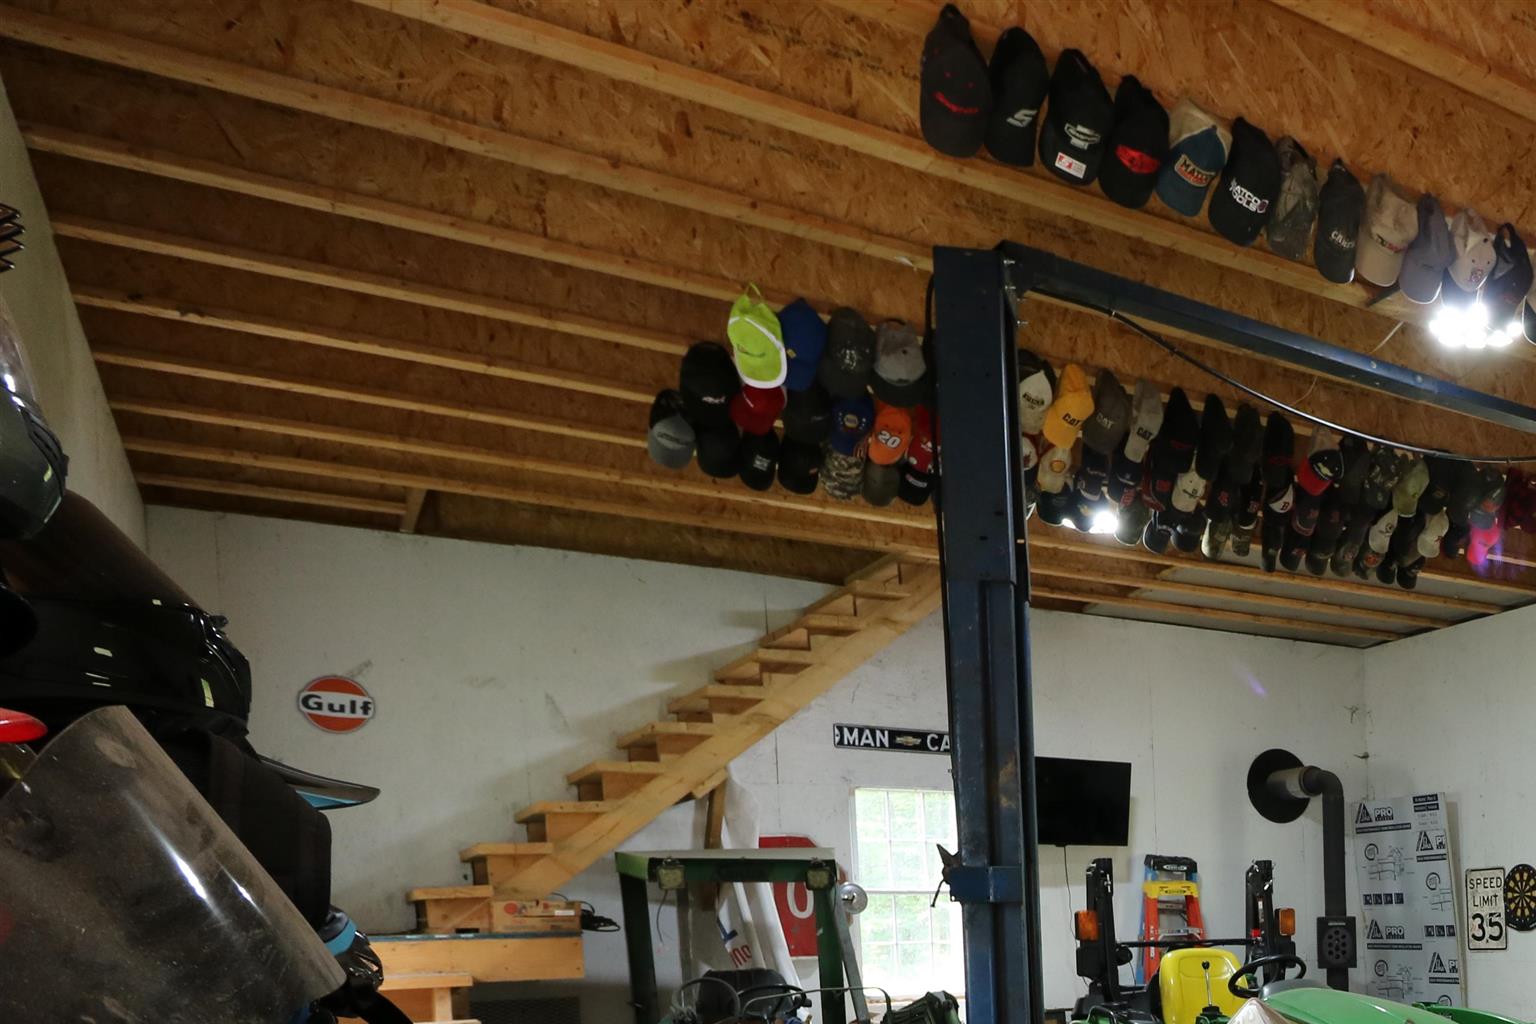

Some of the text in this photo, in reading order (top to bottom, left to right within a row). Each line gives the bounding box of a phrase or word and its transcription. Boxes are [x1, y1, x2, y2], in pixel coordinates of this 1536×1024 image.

[1062, 413, 1080, 427] CAT
[877, 430, 901, 449] 20
[1136, 427, 1153, 440] CAT
[301, 694, 372, 715] Gulf
[843, 727, 889, 748] MAN
[1469, 877, 1503, 890] SPEED
[1472, 894, 1498, 907] LIMIT
[1471, 912, 1503, 941] 35
